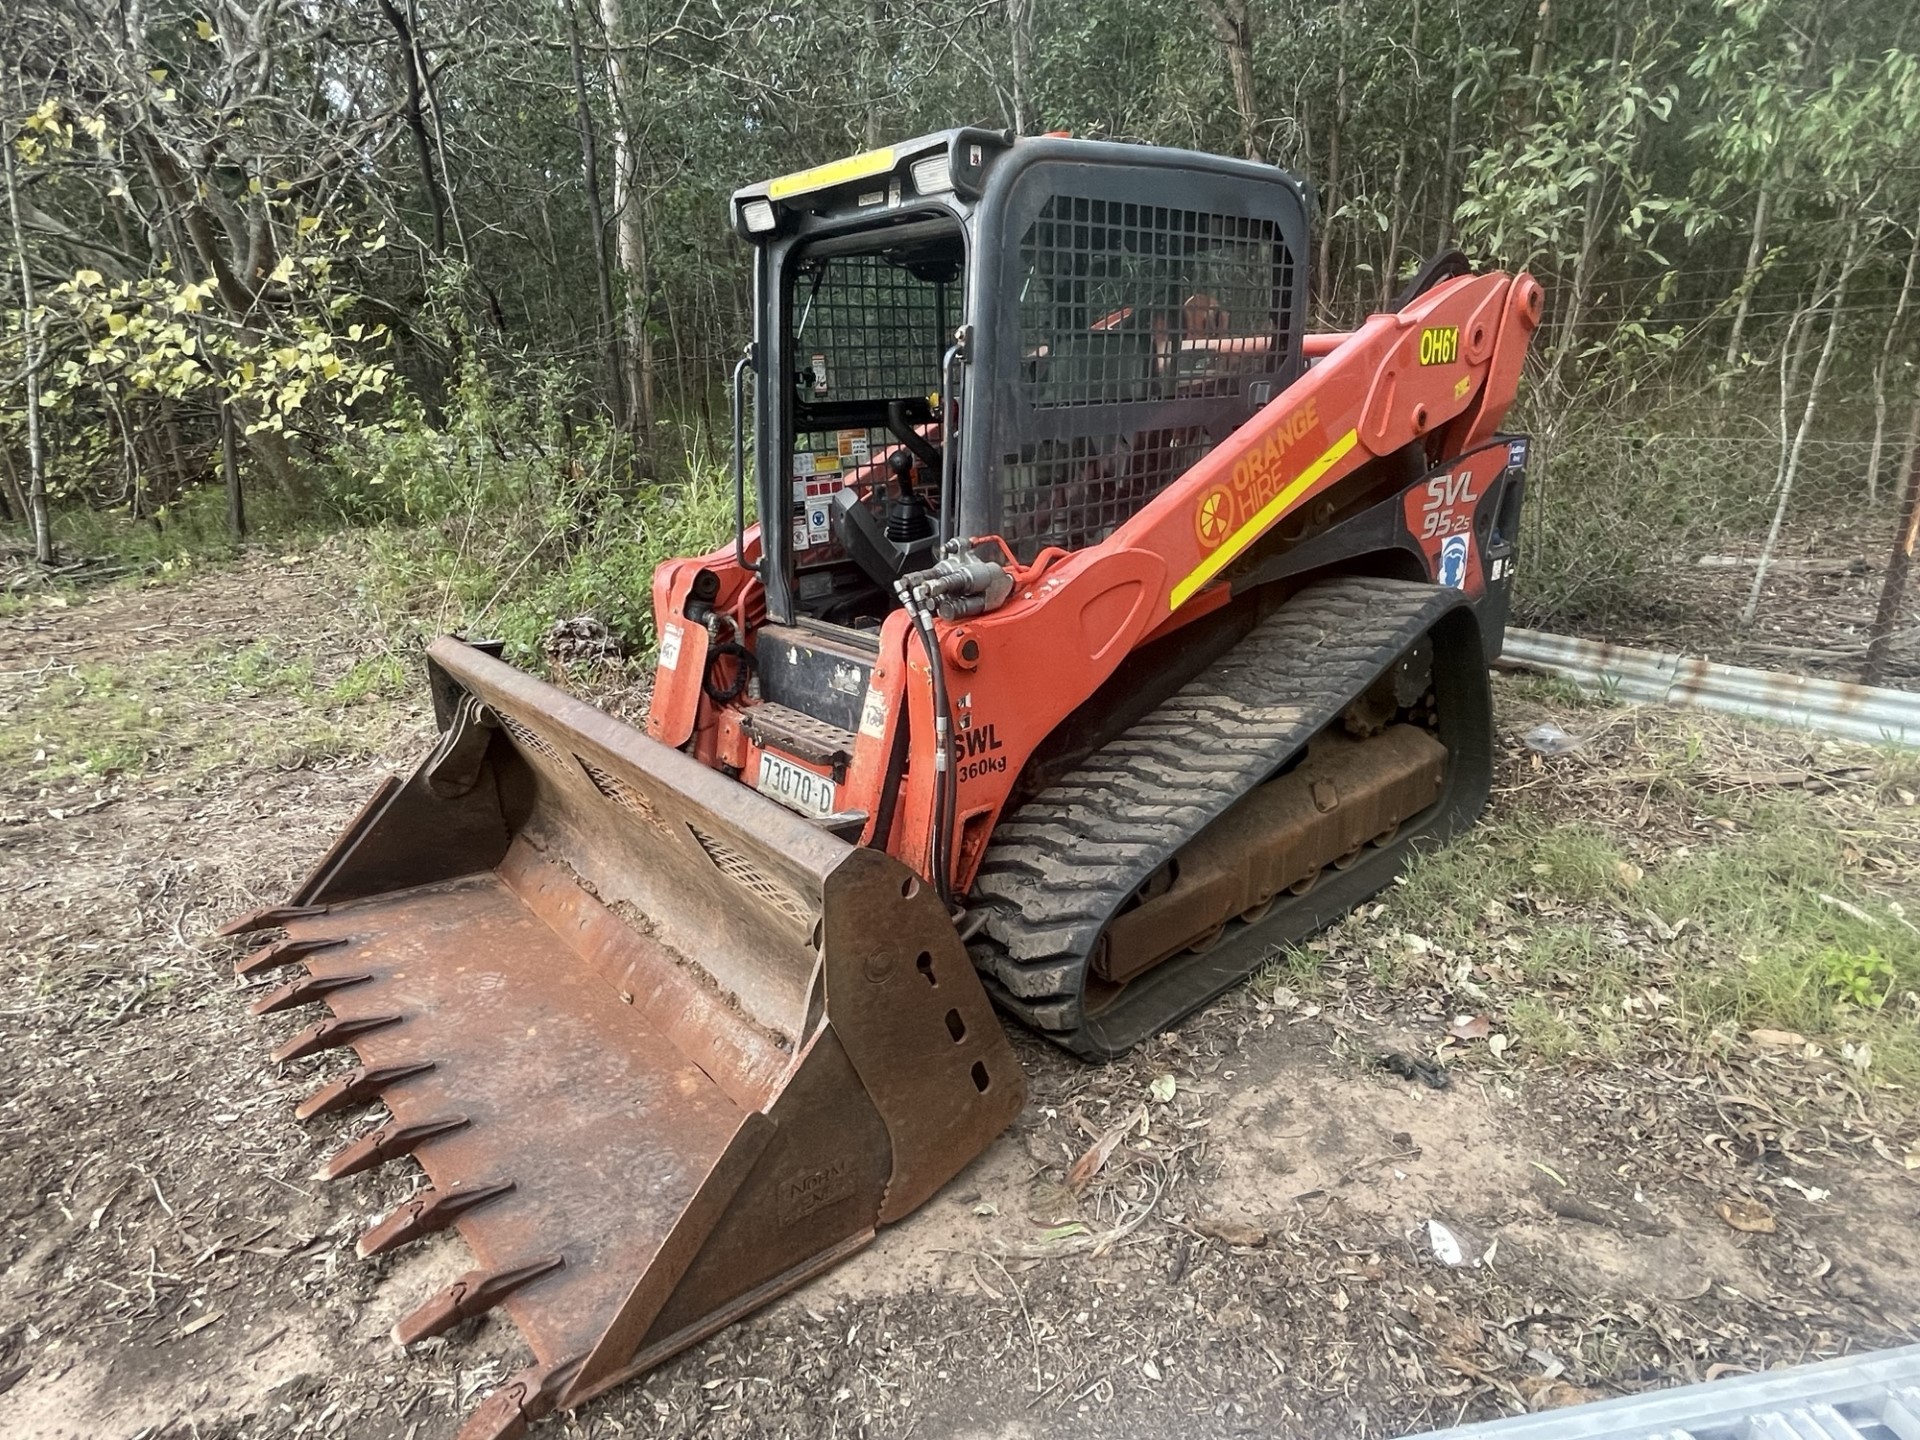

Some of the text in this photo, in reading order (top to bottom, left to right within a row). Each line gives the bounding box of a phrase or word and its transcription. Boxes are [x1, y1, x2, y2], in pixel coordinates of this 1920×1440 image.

[1421, 328, 1459, 365] OH61
[1232, 396, 1319, 491] ORANGE
[1238, 460, 1285, 523] HIRE
[1423, 471, 1478, 511] SVL
[954, 723, 1002, 763] SWL
